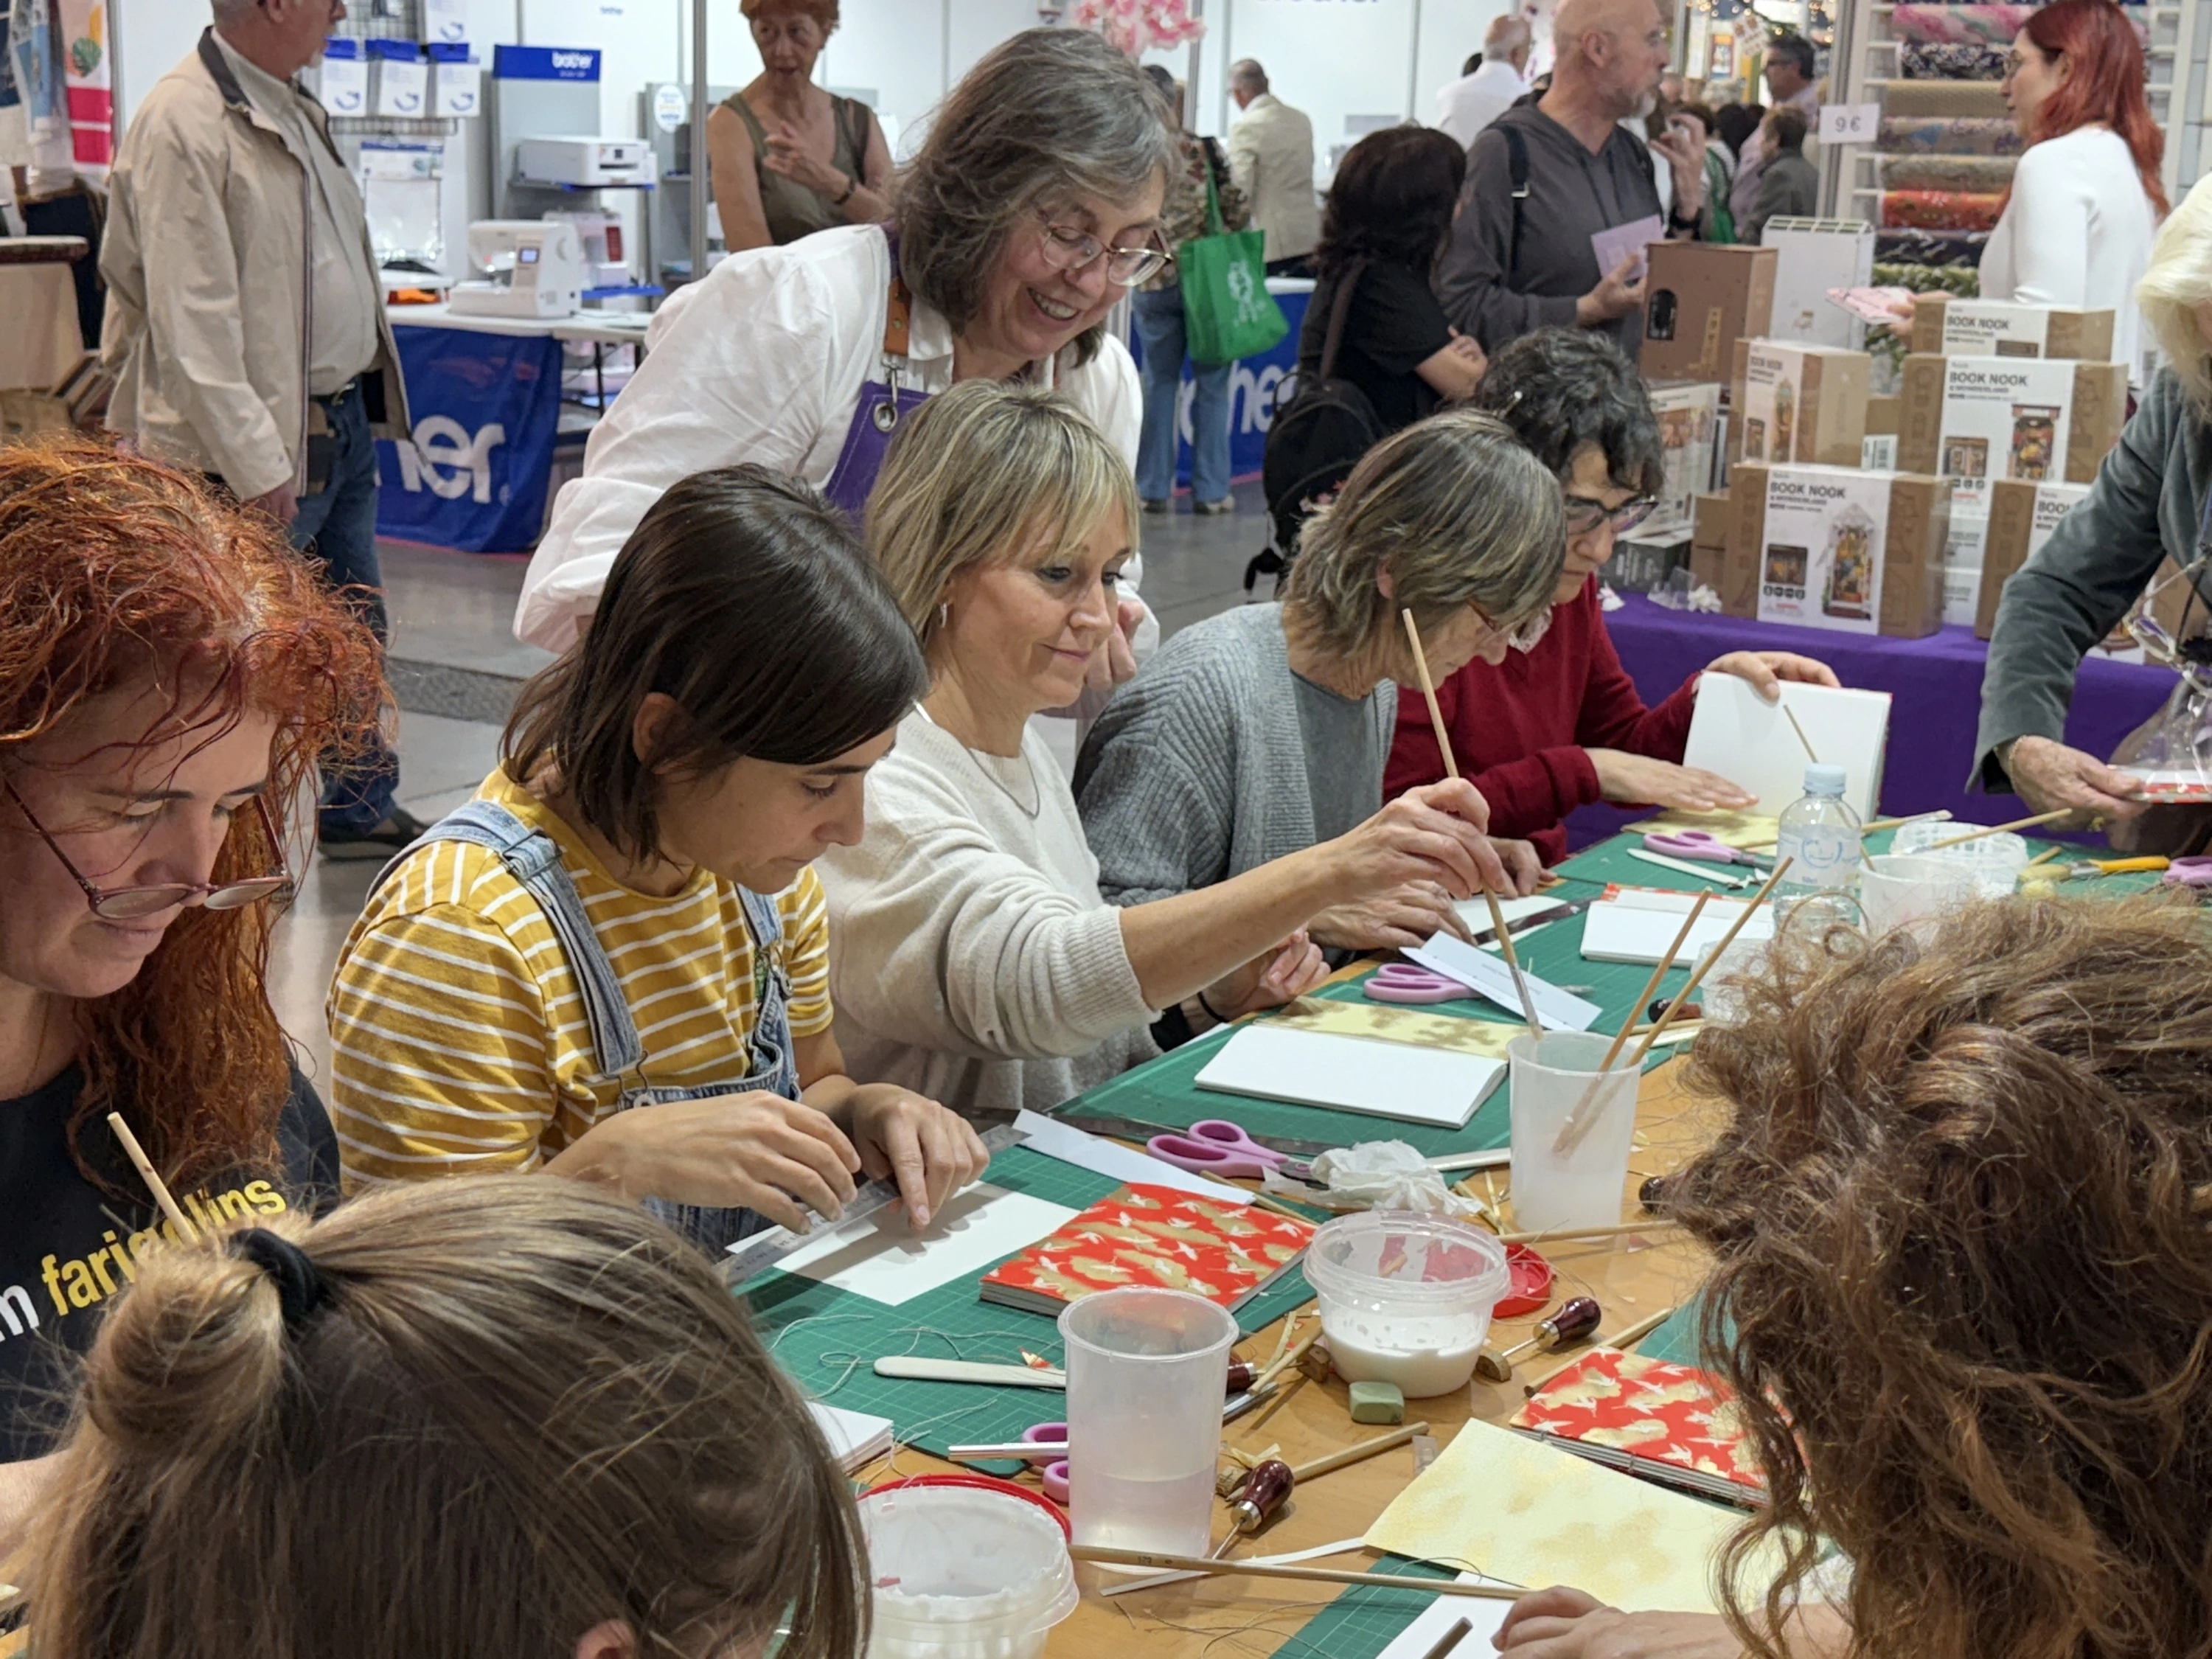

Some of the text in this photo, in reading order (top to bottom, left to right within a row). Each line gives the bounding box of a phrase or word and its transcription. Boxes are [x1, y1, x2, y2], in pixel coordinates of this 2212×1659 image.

[1950, 372, 2028, 386] BOOK NOOK
[1770, 481, 1846, 499] BOOK NOOK
